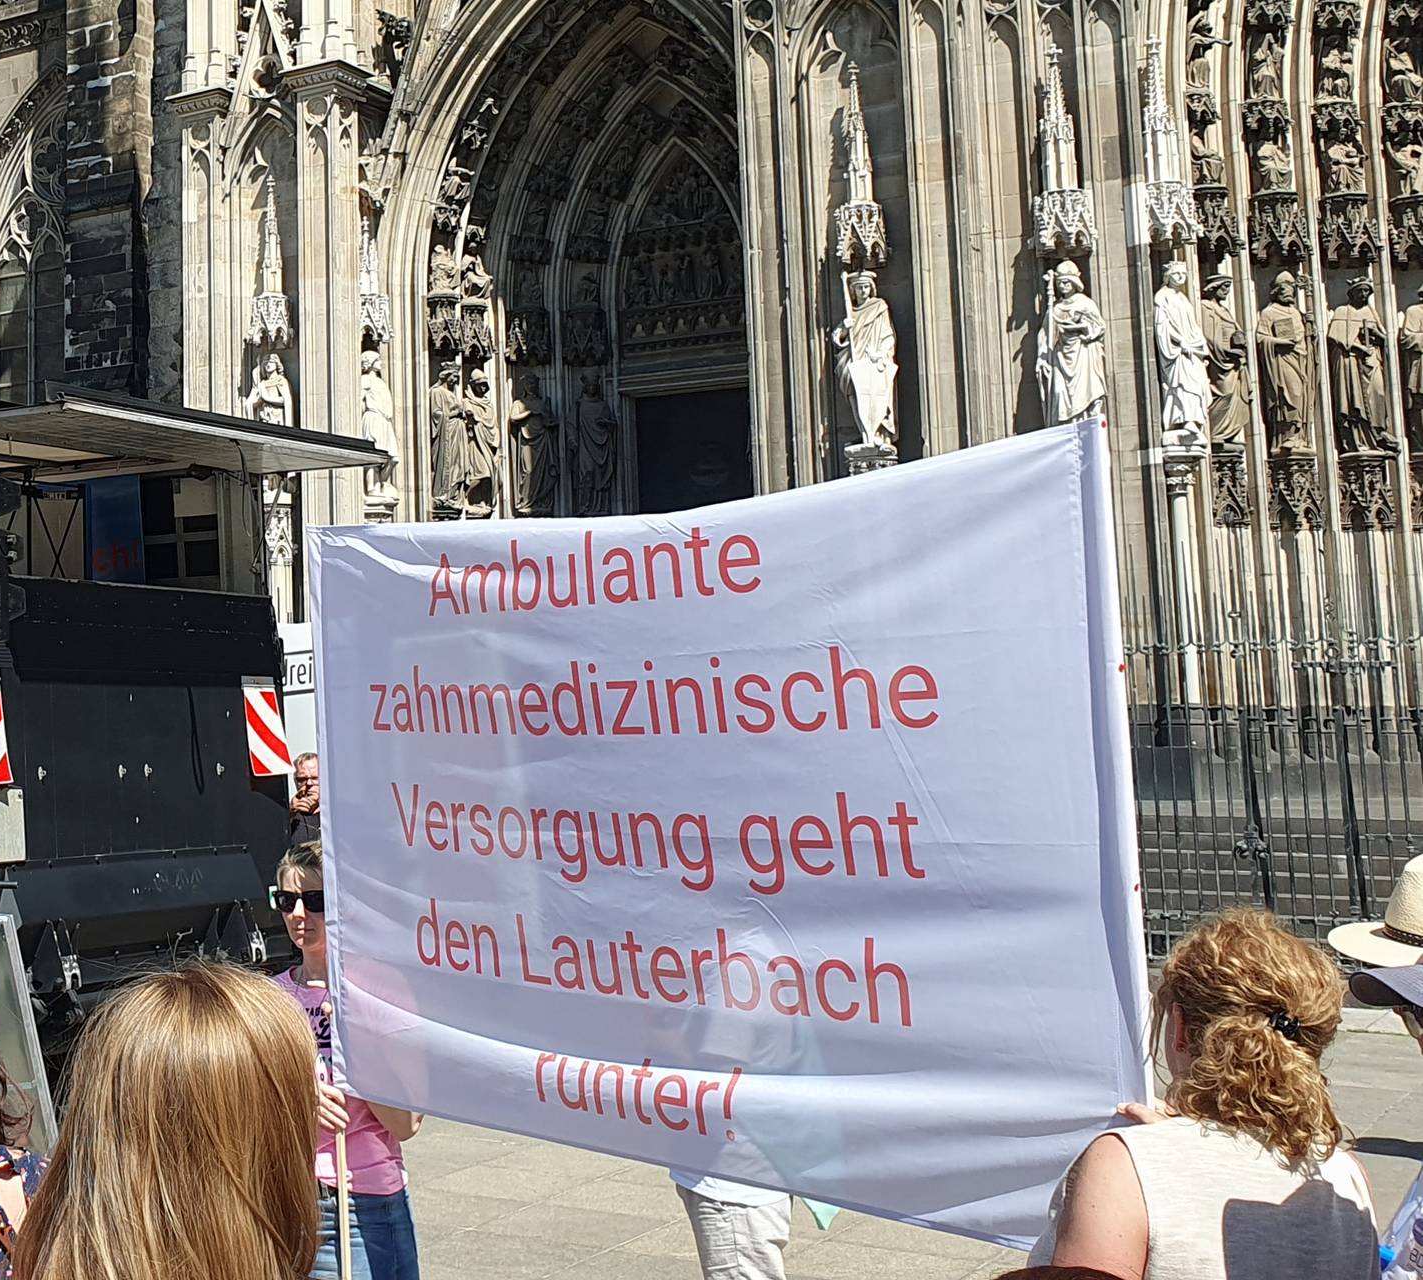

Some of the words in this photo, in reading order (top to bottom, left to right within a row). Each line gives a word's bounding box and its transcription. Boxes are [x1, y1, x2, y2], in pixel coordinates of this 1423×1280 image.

[429, 526, 762, 617] Ambulante
[368, 645, 939, 738] zahnmedizinische
[390, 782, 715, 892] Versorgung
[739, 792, 926, 896] geht
[416, 897, 501, 978] den
[515, 913, 912, 1027] Lauterbach
[534, 1051, 743, 1142] runter!
